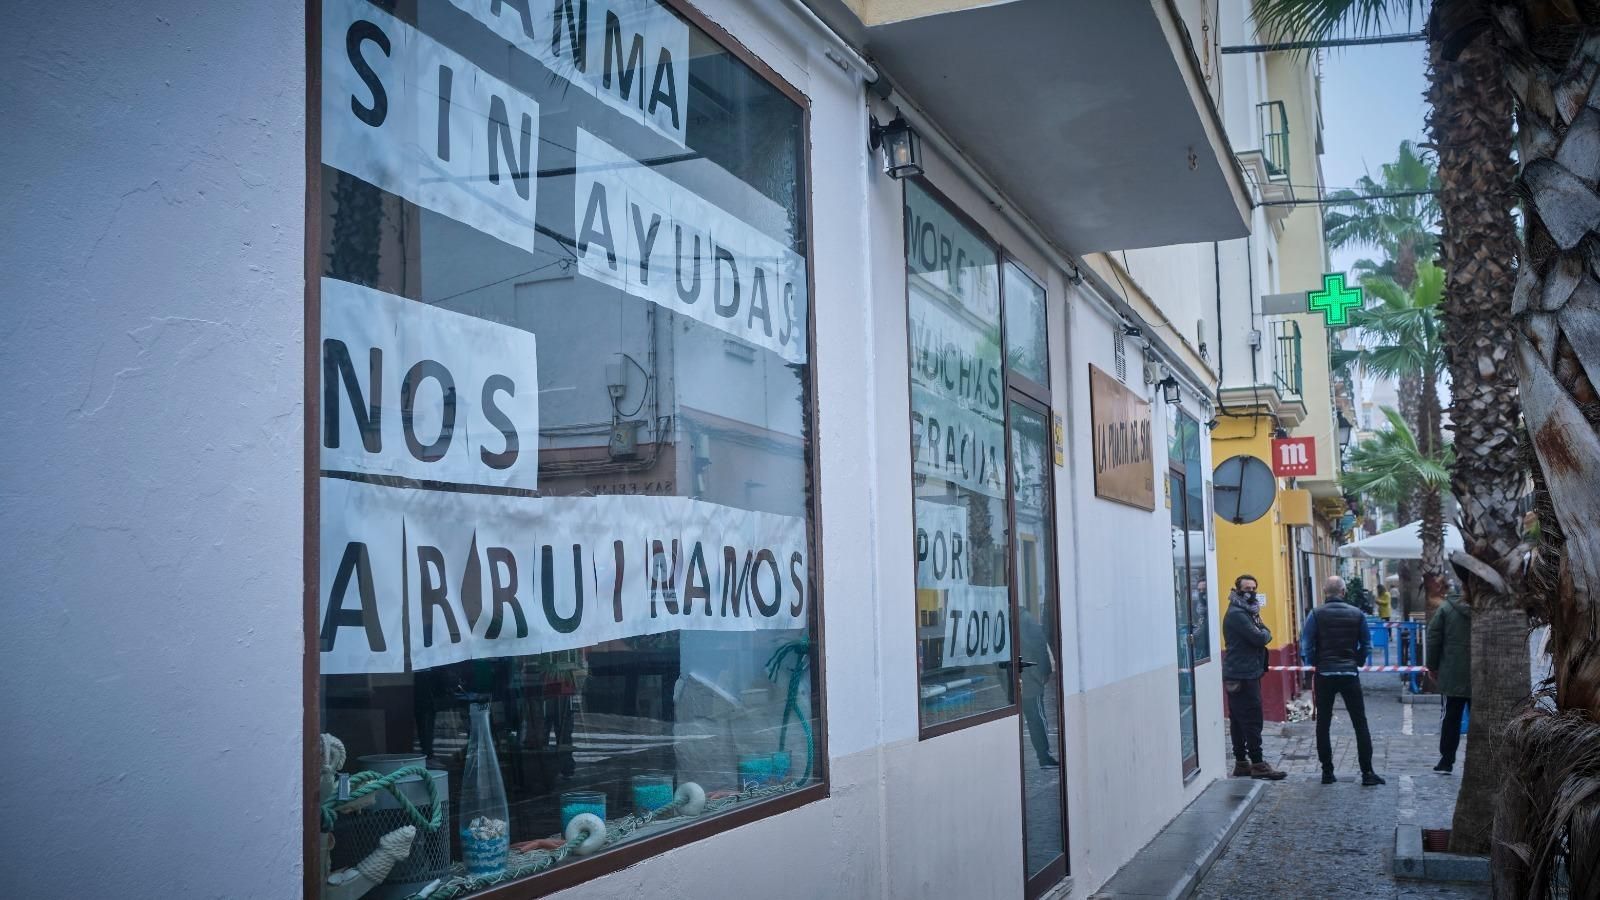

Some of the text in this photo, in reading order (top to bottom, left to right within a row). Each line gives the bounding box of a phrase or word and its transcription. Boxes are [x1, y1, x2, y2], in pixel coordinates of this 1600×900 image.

[346, 19, 532, 201] SIN
[578, 181, 794, 346] AYUDAS
[323, 338, 520, 470] NOS
[320, 540, 803, 652] ARRUINAMOS
[916, 527, 963, 580] POR
[949, 608, 1006, 658] TODO
